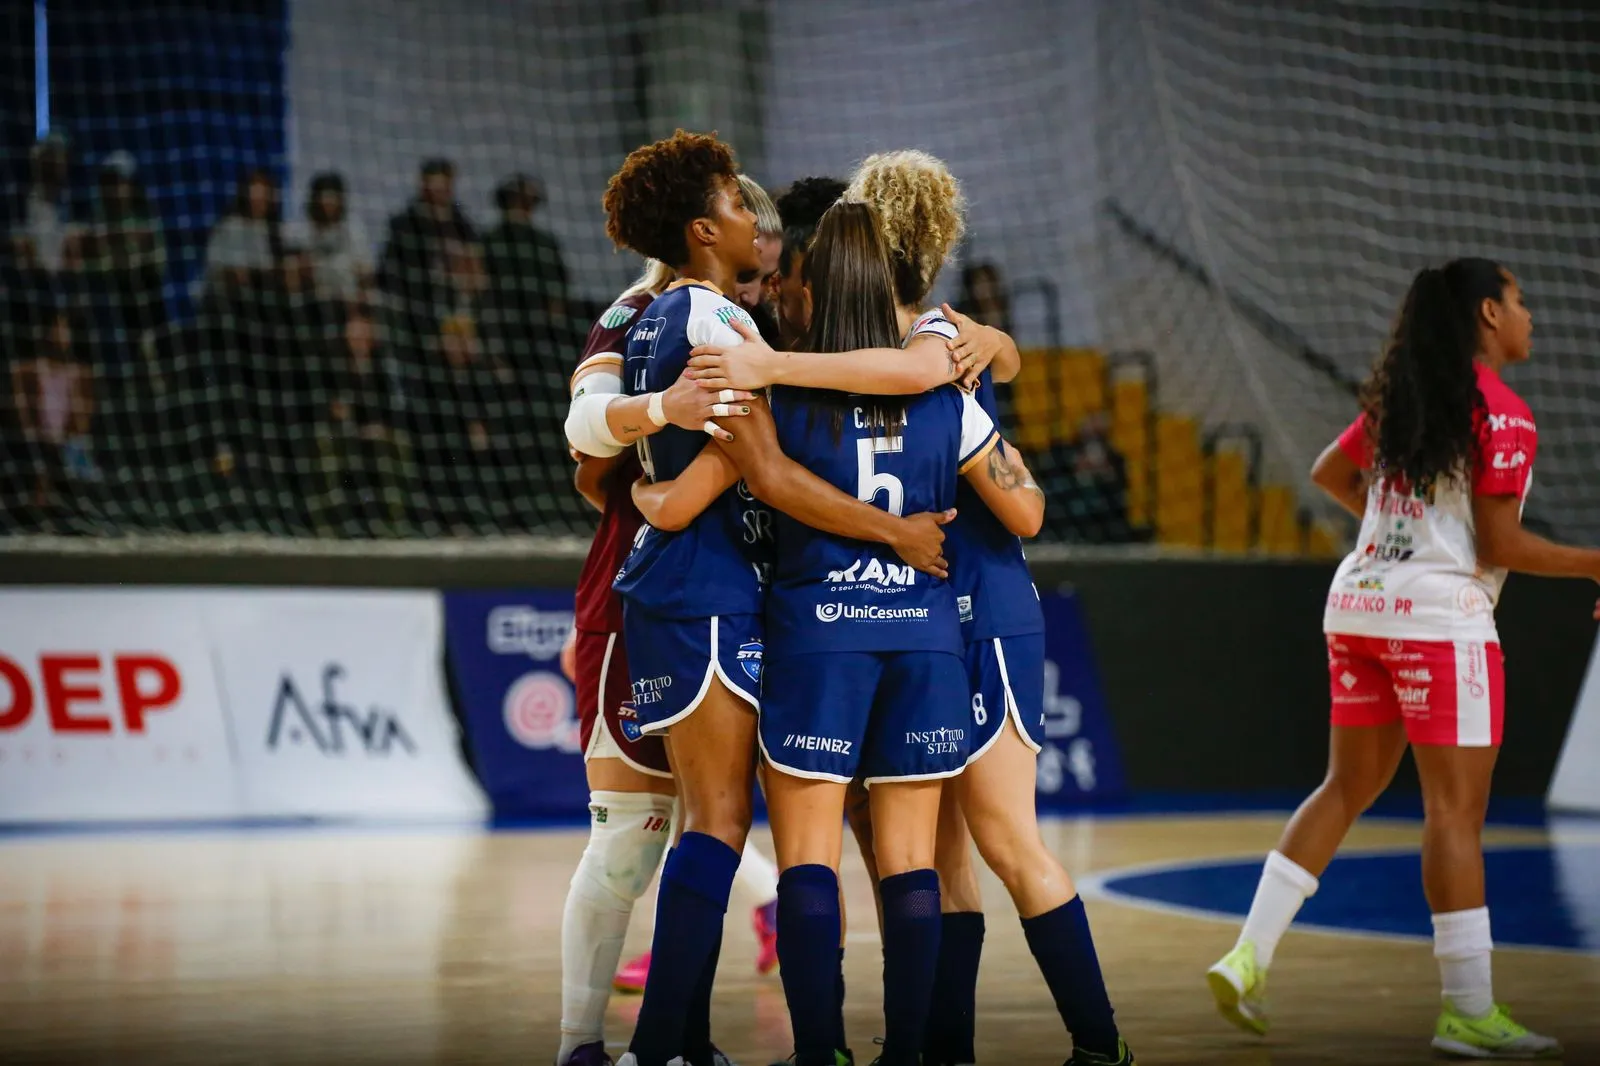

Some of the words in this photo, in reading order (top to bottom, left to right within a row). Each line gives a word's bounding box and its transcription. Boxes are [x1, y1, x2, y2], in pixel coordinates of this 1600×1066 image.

[856, 435, 904, 516] 5
[843, 604, 929, 619] UniCesumar
[1394, 595, 1413, 616] PR
[971, 692, 988, 726] 8
[927, 741, 958, 755] STEIN
